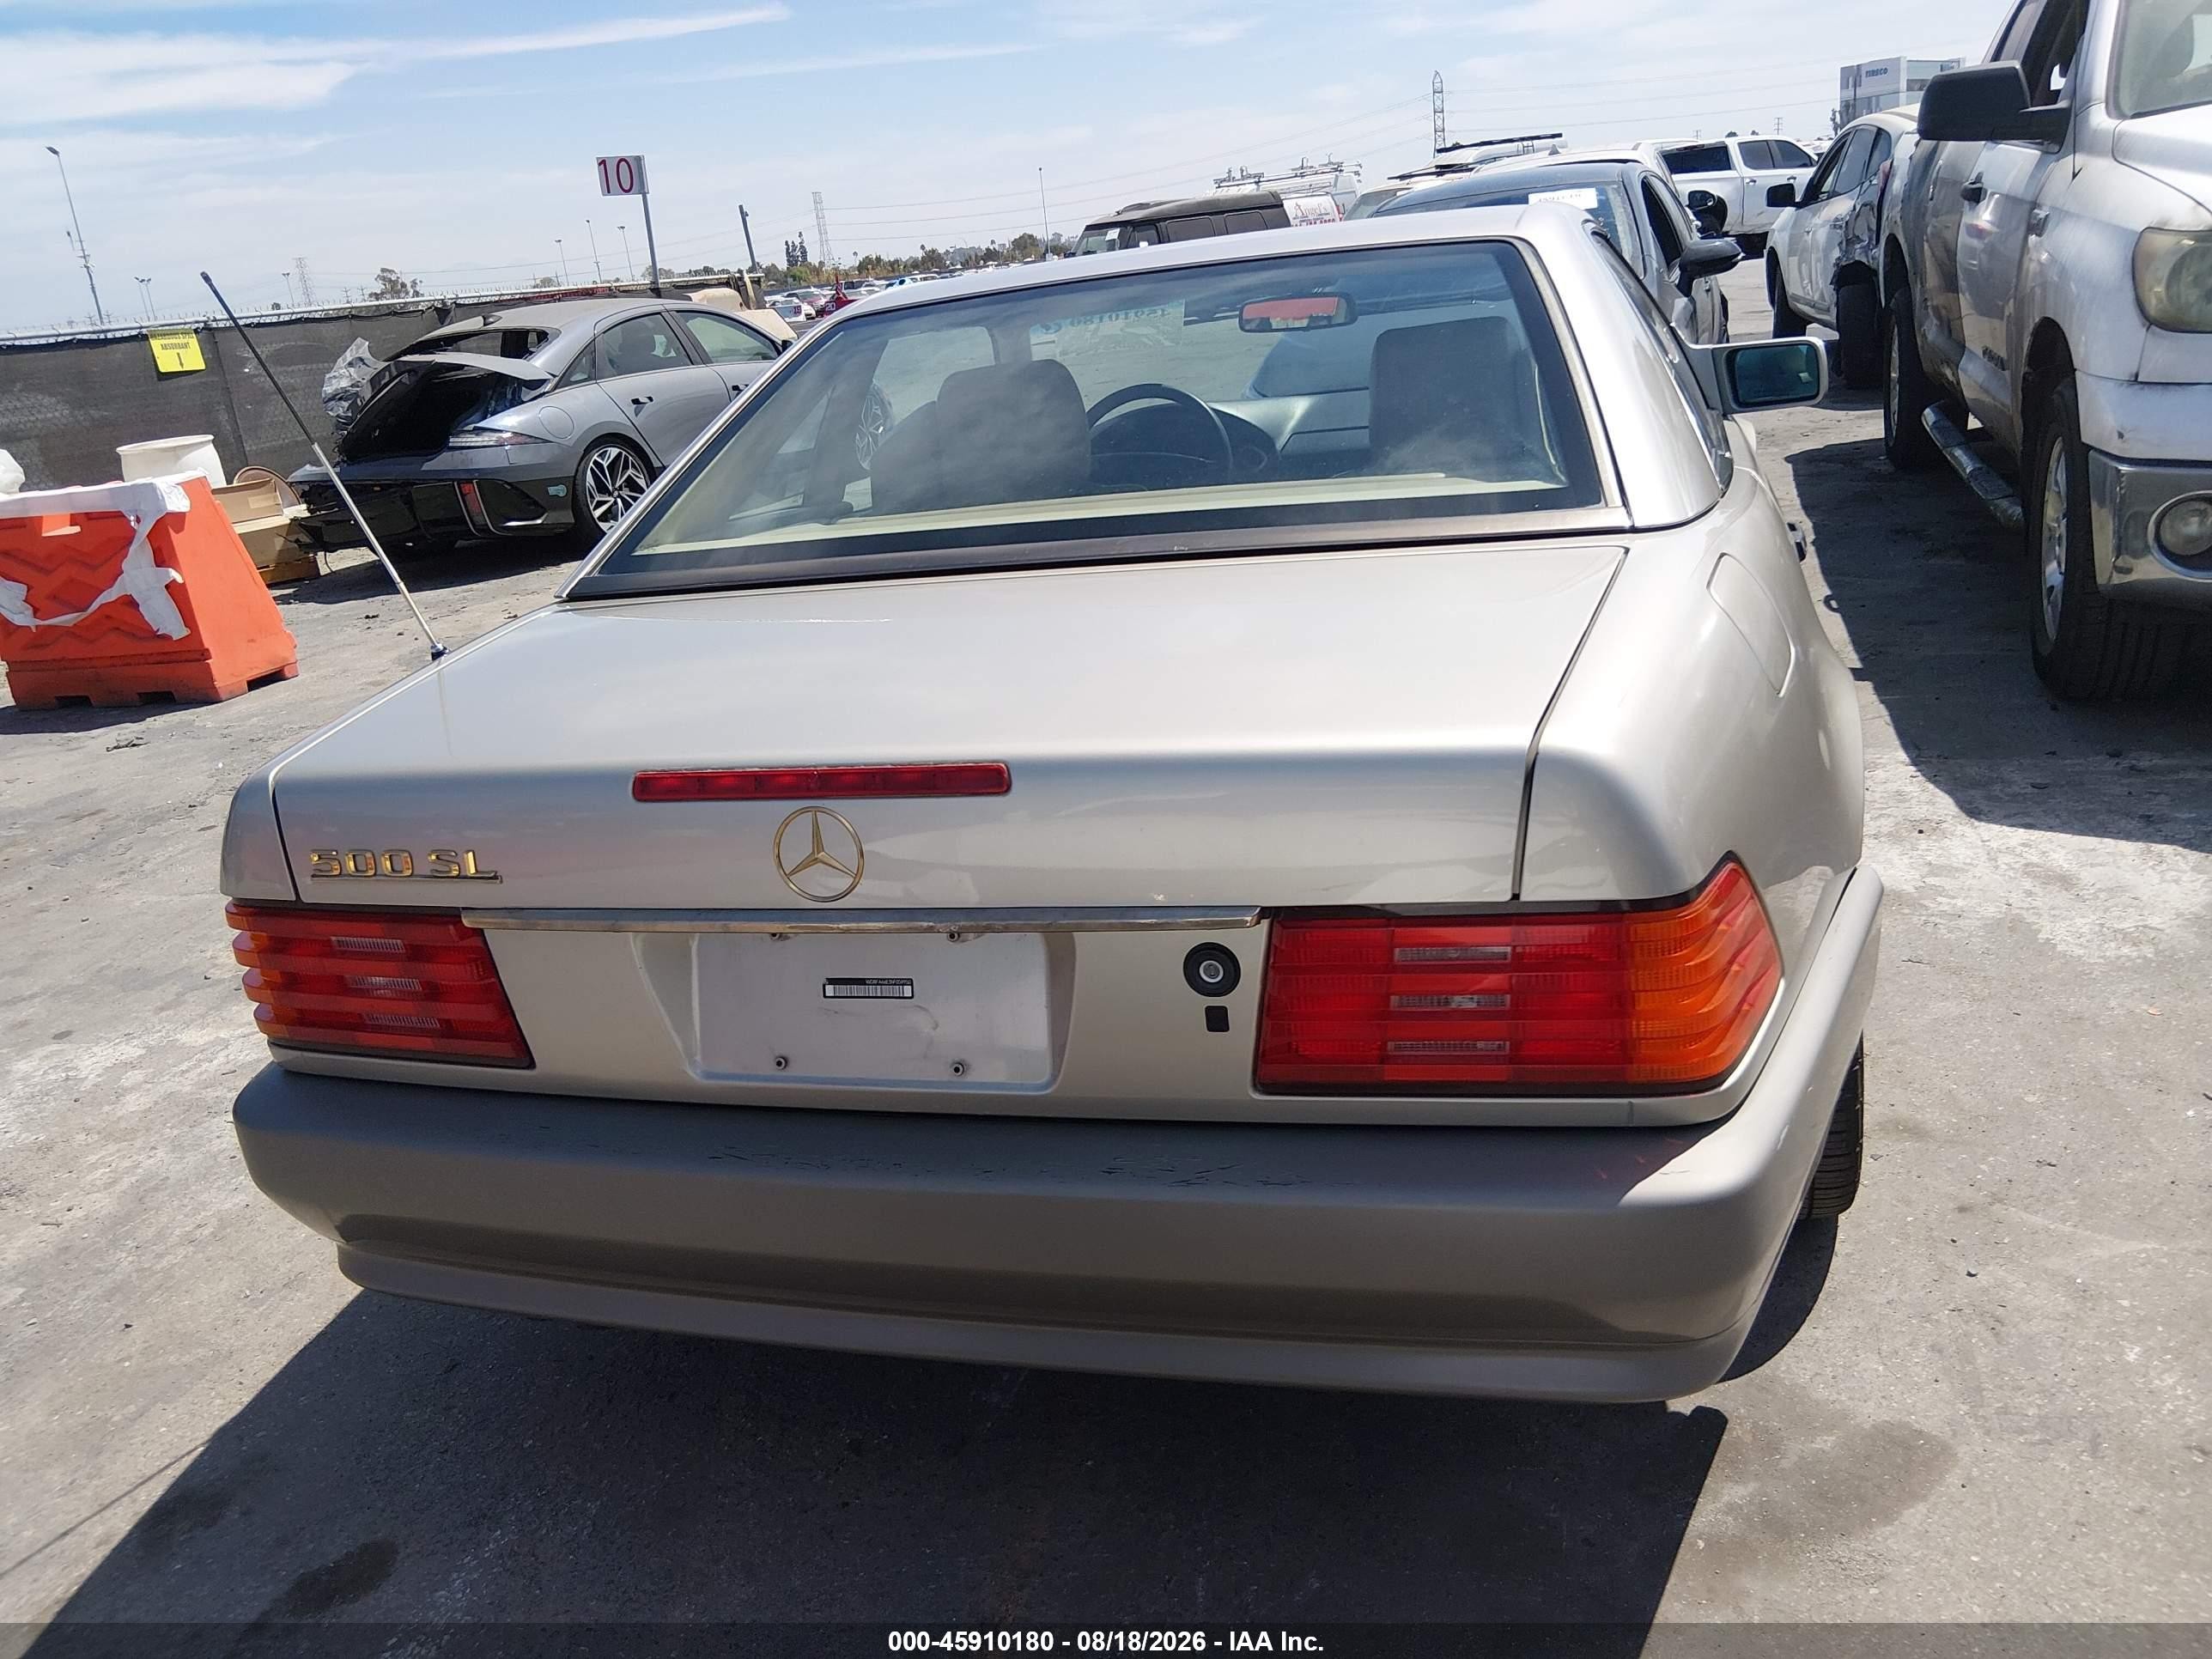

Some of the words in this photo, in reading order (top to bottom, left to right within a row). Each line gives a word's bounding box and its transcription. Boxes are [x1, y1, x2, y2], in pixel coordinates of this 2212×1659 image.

[598, 158, 634, 194] 10
[826, 302, 836, 311] 20
[310, 849, 413, 877] 500
[428, 849, 498, 878] SL
